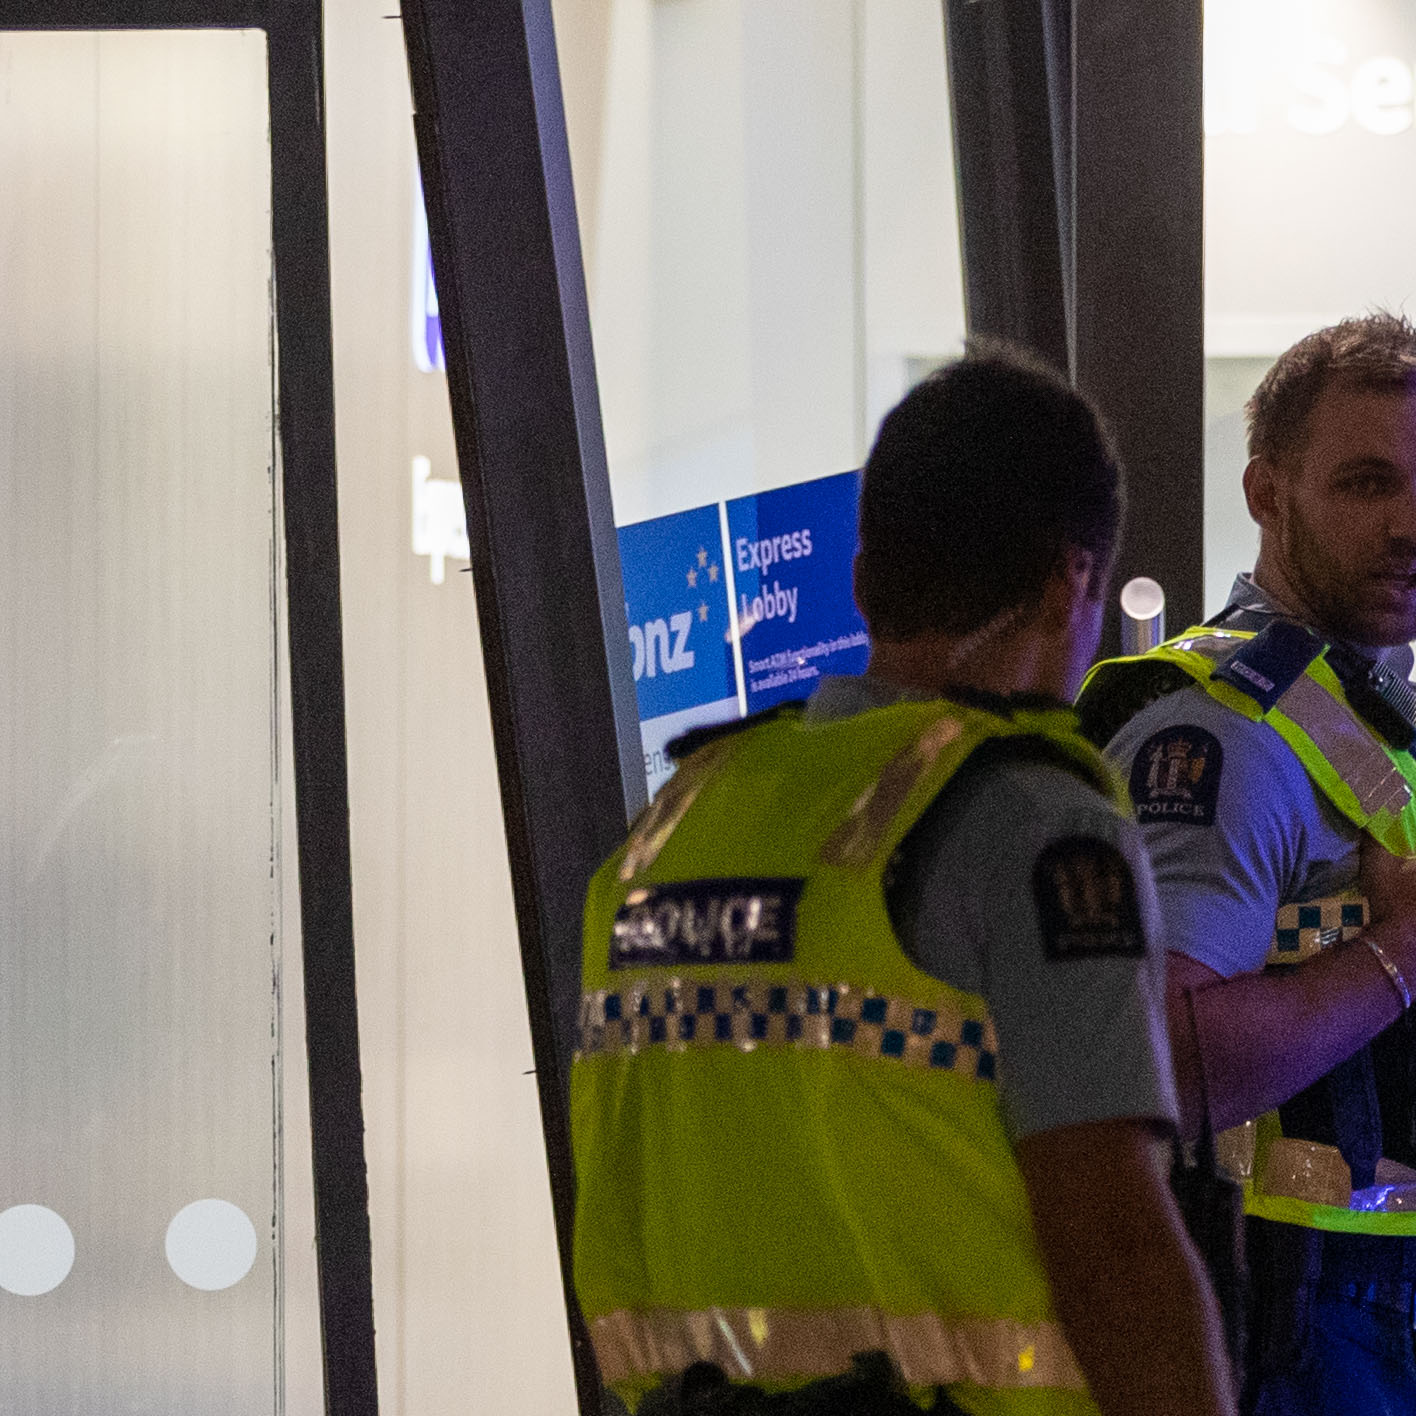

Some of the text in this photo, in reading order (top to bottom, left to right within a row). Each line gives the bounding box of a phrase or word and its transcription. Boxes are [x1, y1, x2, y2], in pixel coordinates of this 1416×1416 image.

[735, 528, 813, 577] Express
[740, 579, 799, 624] Lobby
[1137, 802, 1205, 816] POLICE
